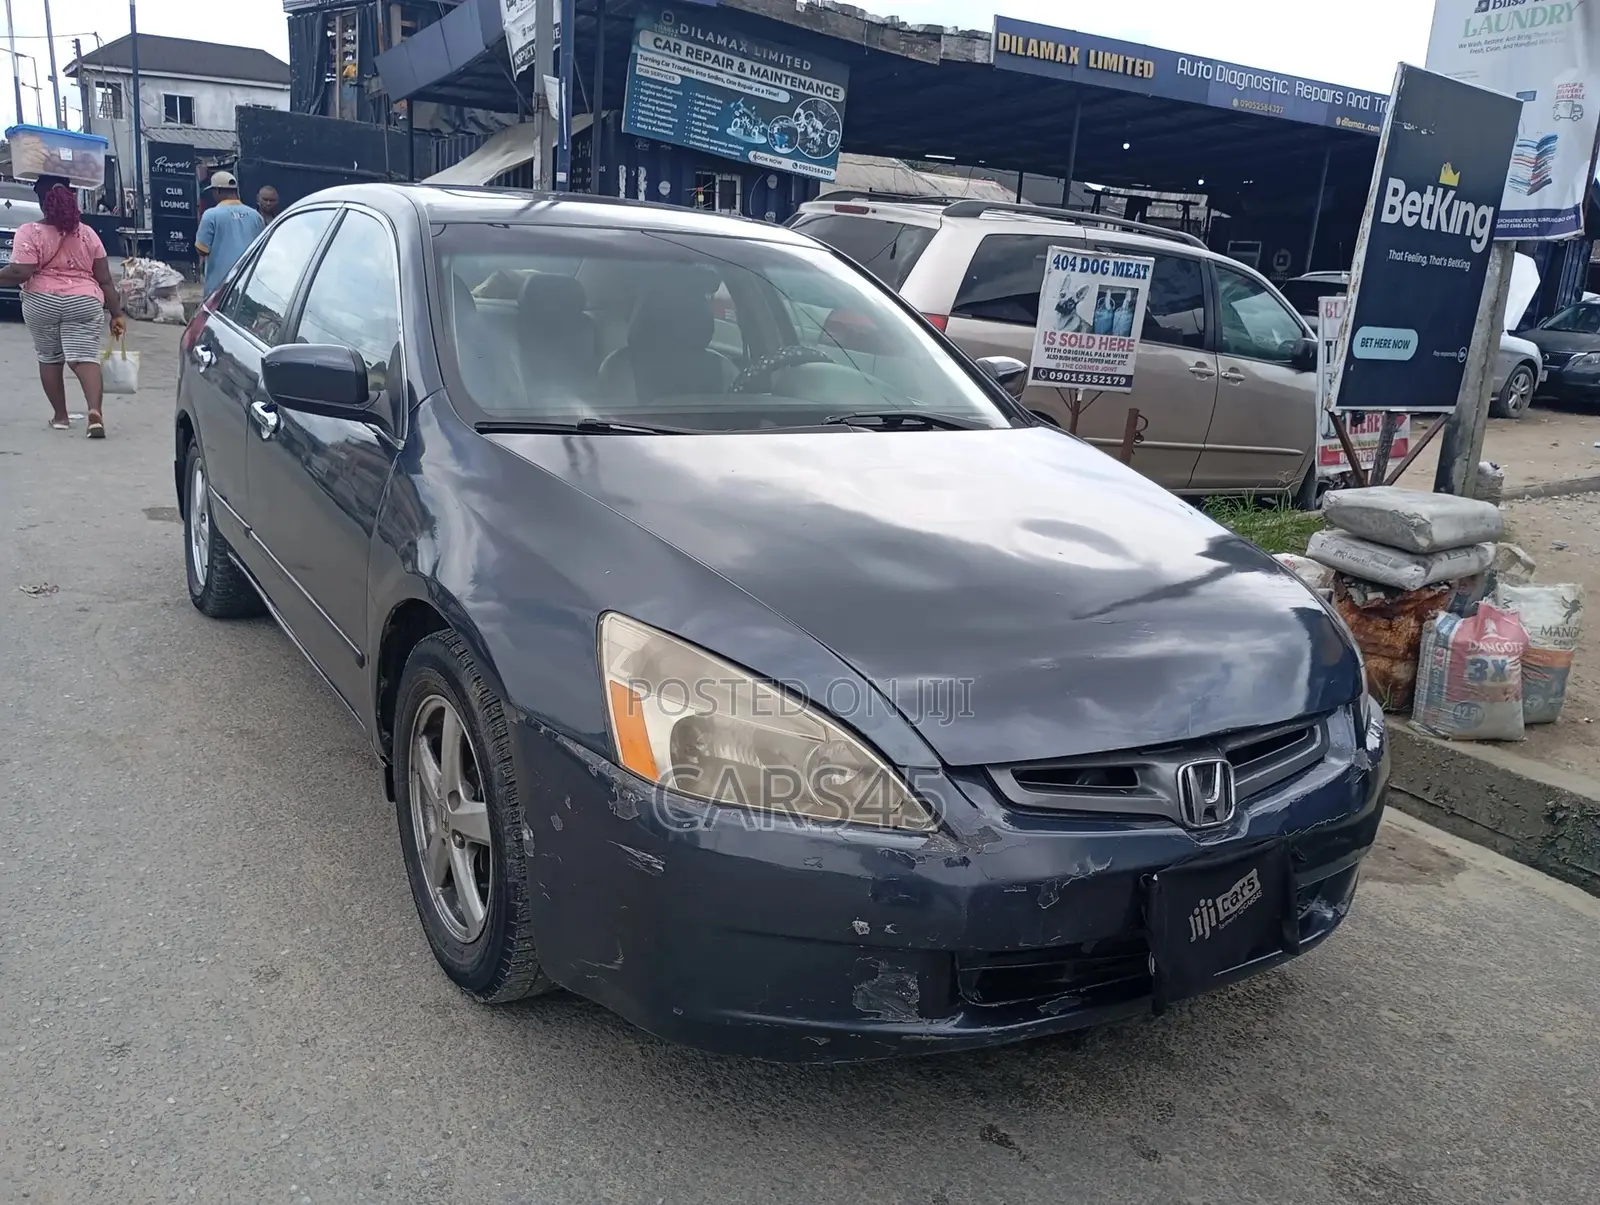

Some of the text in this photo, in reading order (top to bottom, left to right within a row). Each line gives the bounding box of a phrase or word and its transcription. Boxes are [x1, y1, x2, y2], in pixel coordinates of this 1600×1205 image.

[1462, 1, 1579, 38] LAUNDRY
[680, 23, 747, 53] DILAMAX
[754, 46, 811, 71] LIMITED
[998, 32, 1154, 79] DILAMAX LIMITED
[653, 37, 840, 99] CAR REPAIR & MAINTENANCE
[1177, 57, 1213, 79] Auto
[1295, 81, 1344, 105] Repairs
[1346, 91, 1370, 110] And
[165, 187, 183, 195] CLUB
[160, 200, 190, 209] LOUNGE
[1380, 176, 1495, 253] BetKing
[1053, 254, 1150, 280] 404 DOG MEAT
[1388, 249, 1471, 272] That Feeling, That's BetKing
[1043, 331, 1136, 352] IS SOLD HERE
[1062, 348, 1093, 357] ORIGINAL
[1094, 350, 1111, 358] PALM
[1360, 337, 1411, 350] BET HERE NOW
[1049, 371, 1126, 385] 09015352179
[1469, 640, 1525, 653] DANGOTE
[1468, 658, 1508, 683] 3X
[1188, 876, 1256, 943] jiji cars
